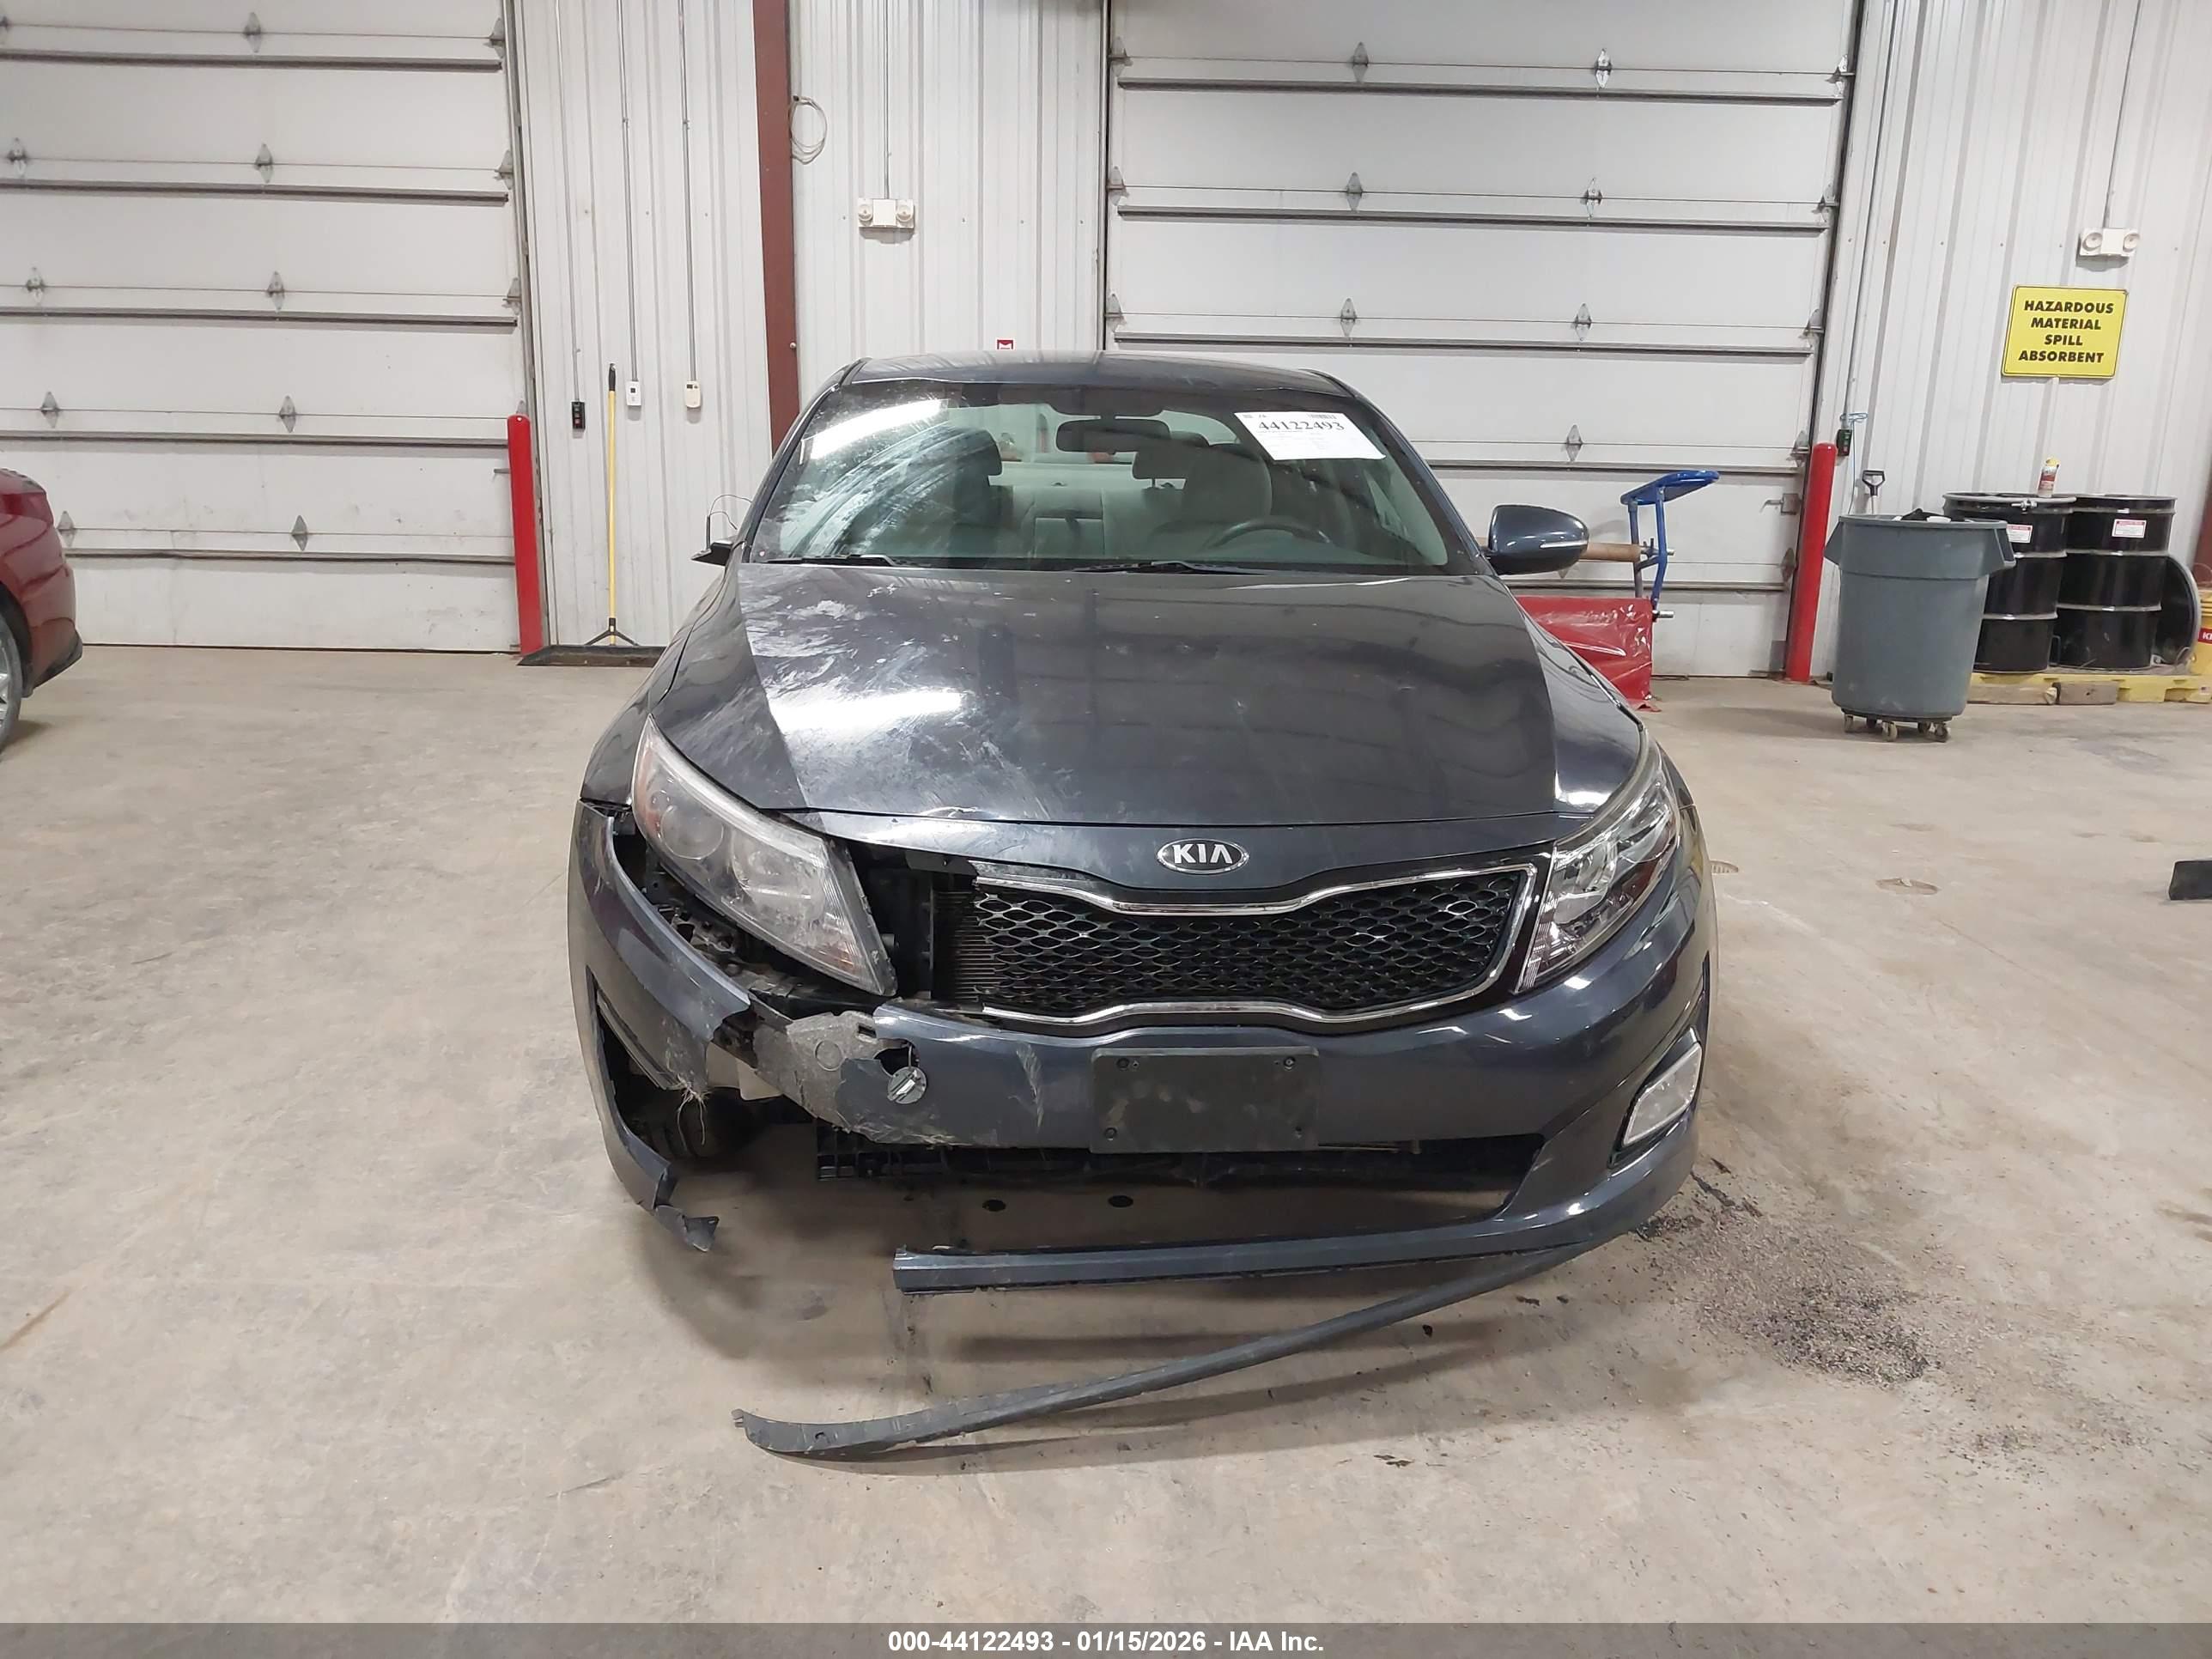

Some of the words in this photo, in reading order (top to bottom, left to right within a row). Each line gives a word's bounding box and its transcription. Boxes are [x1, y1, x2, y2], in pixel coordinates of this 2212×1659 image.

[2024, 301, 2114, 313] HAZARDOUS
[2031, 318, 2101, 330] MATERIAL
[2044, 334, 2083, 345] SPILL
[2019, 350, 2104, 363] ABSORBENT
[1258, 421, 1345, 430] 44122493
[1172, 843, 1233, 864] KIA
